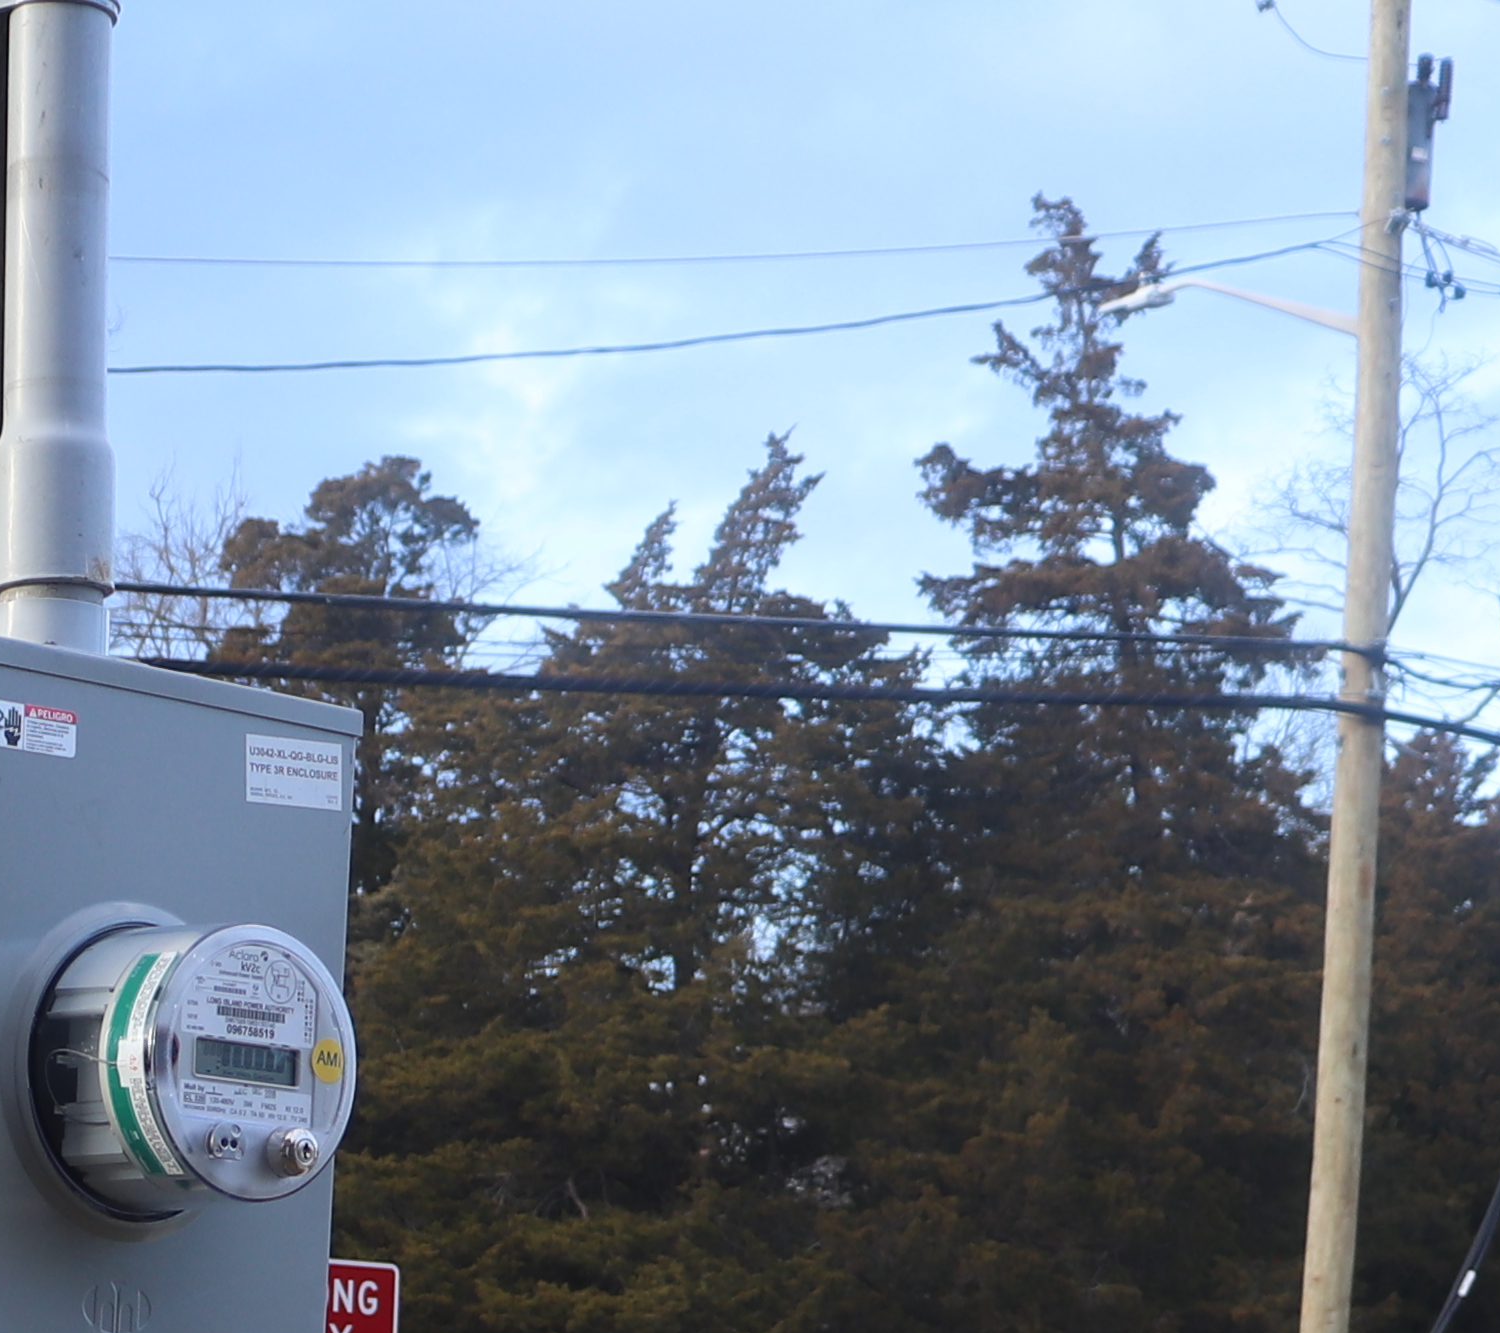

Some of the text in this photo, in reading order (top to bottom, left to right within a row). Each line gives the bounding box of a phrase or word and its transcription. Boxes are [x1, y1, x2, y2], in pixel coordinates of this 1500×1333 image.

[37, 708, 73, 723] PELIGRO
[249, 762, 338, 781] TYPE 3R ENCLOSURE
[244, 1001, 264, 1011] POWER
[226, 1023, 275, 1039] 096758519
[328, 1277, 379, 1316] NG
